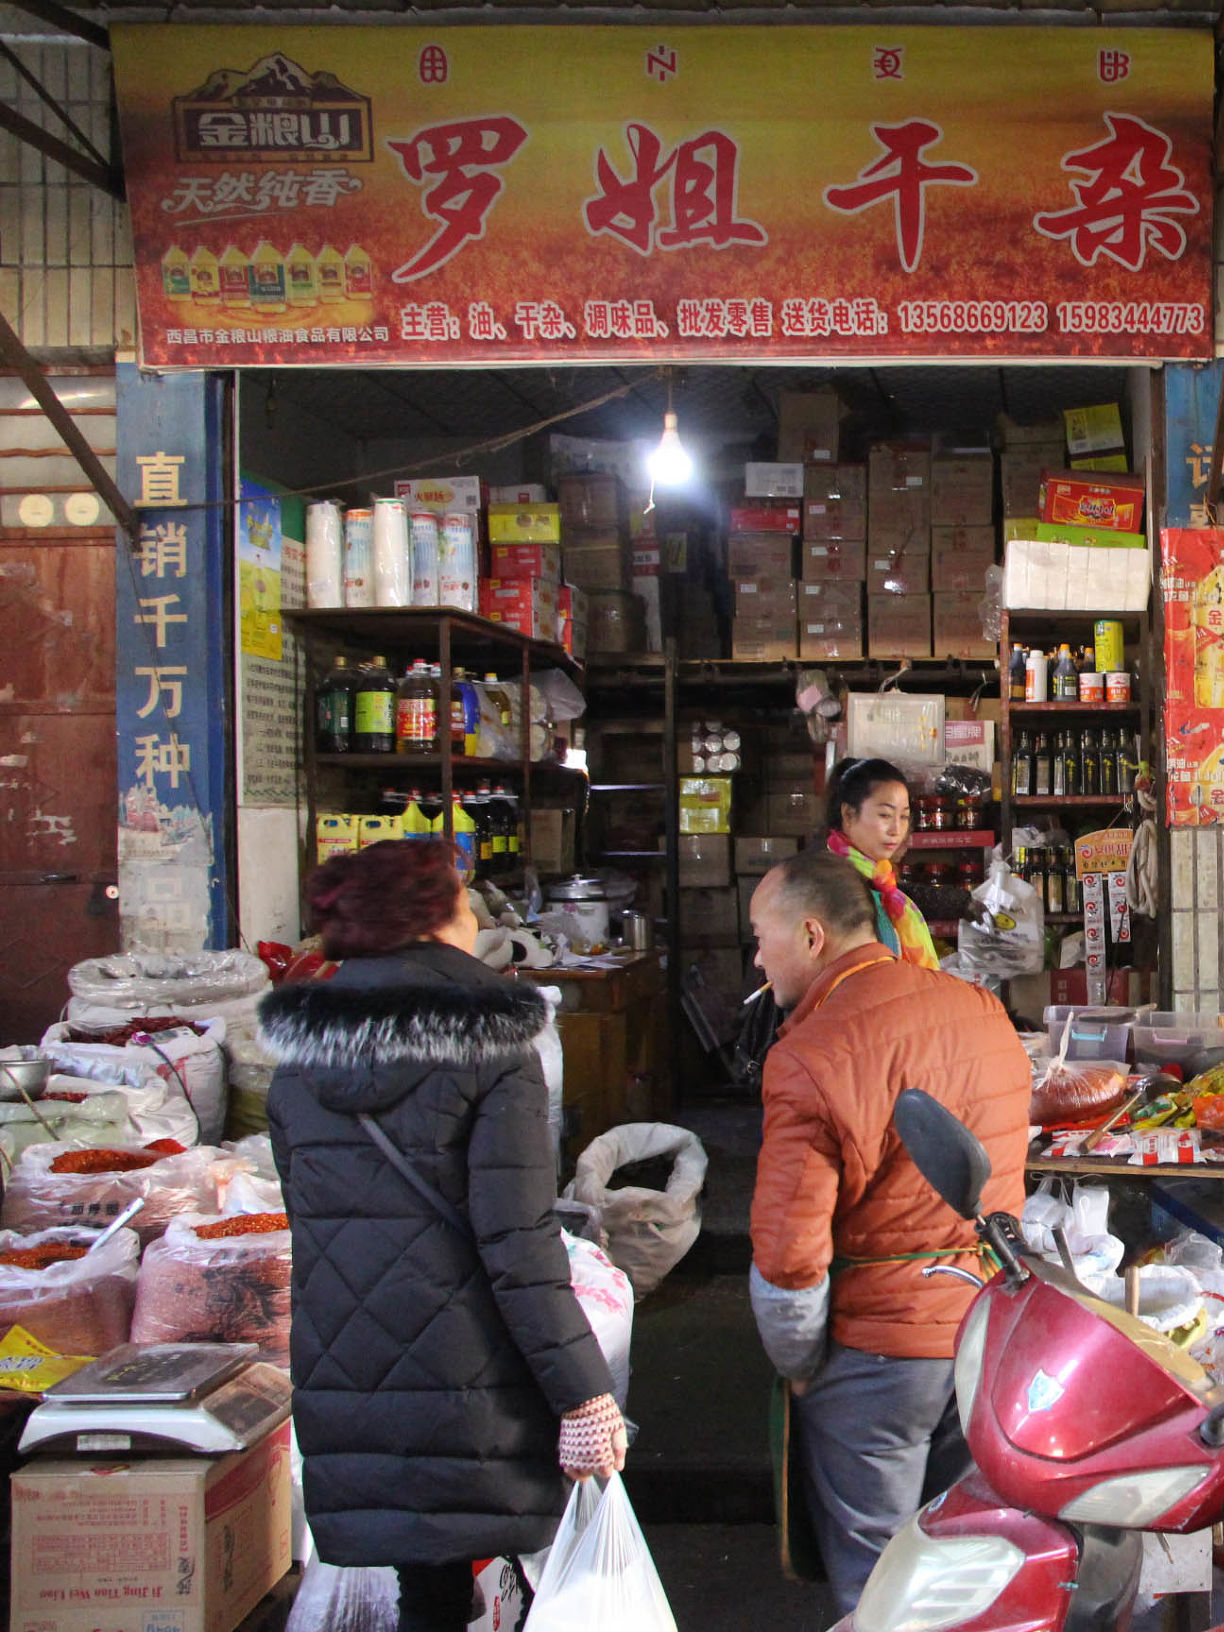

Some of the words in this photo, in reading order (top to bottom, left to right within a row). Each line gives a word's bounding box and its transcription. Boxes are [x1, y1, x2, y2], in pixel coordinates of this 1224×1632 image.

[198, 112, 350, 149] 金粮山
[161, 169, 363, 213] 天然纯香
[387, 113, 1200, 283] 罗姐干杂
[166, 326, 390, 345] 西昌市金粮山粮油食品有限公司
[1056, 301, 1204, 335] 15983444773
